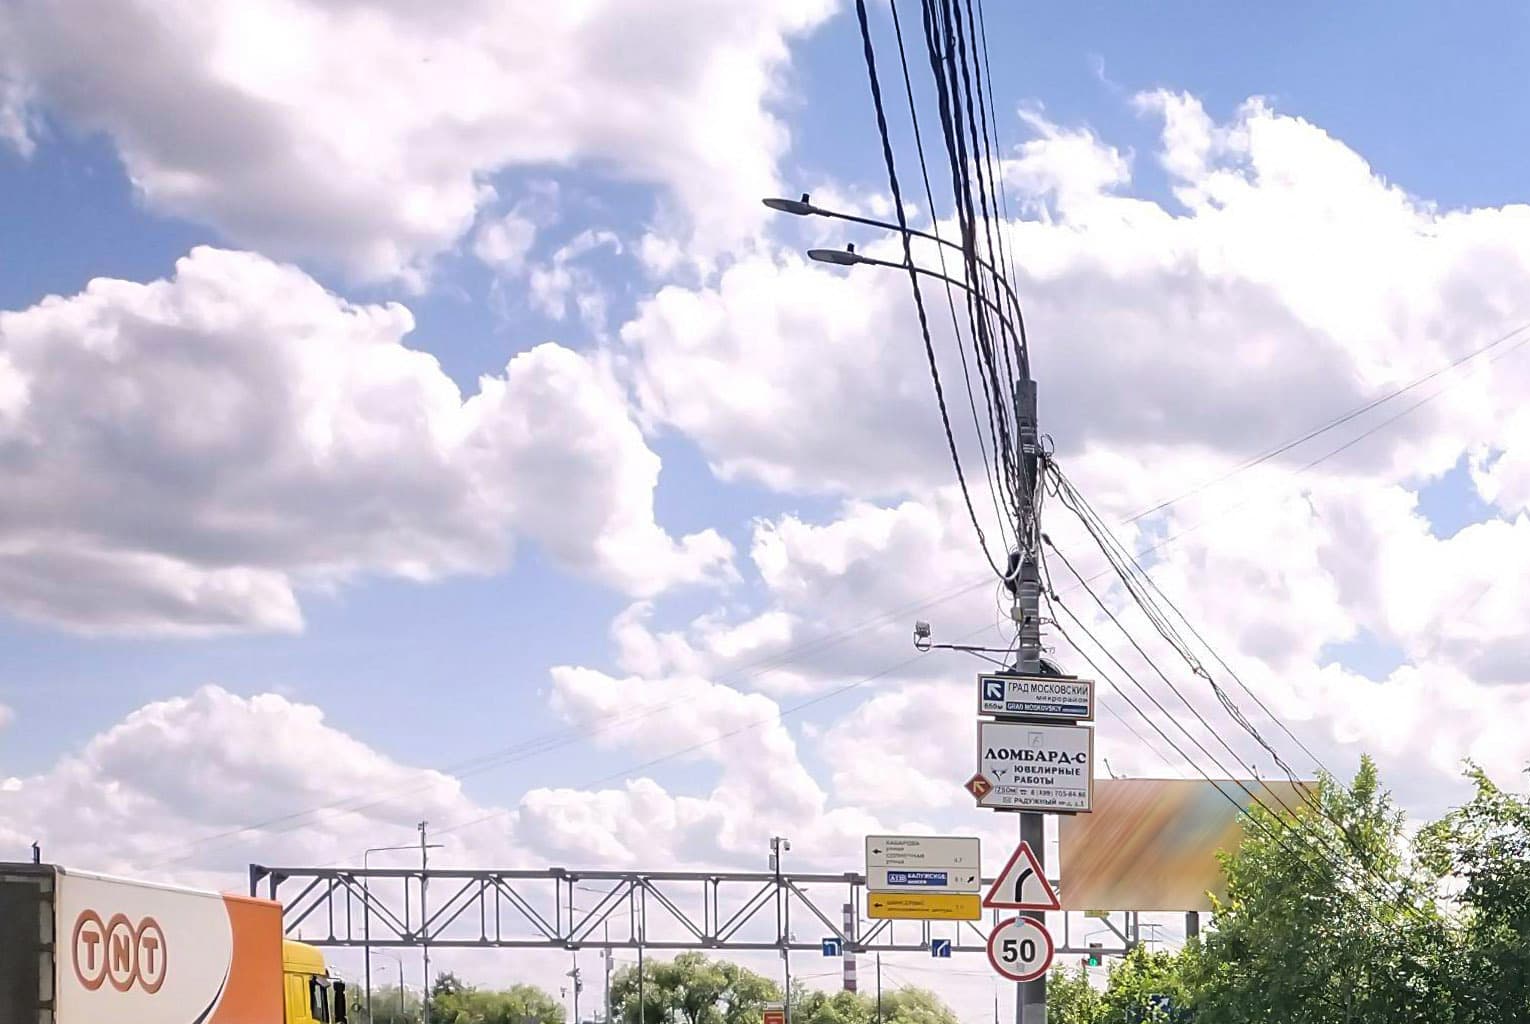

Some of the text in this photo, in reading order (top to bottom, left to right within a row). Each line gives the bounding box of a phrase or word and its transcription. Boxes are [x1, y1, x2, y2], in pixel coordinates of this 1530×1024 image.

[1008, 682, 1029, 692] ГРАД
[984, 747, 1087, 764] ЛОМБАРД-С
[1014, 765, 1081, 776] ЮВЕЛИРНЫЕ
[1014, 775, 1054, 785] РАБОТЫ
[1002, 939, 1036, 963] 50
